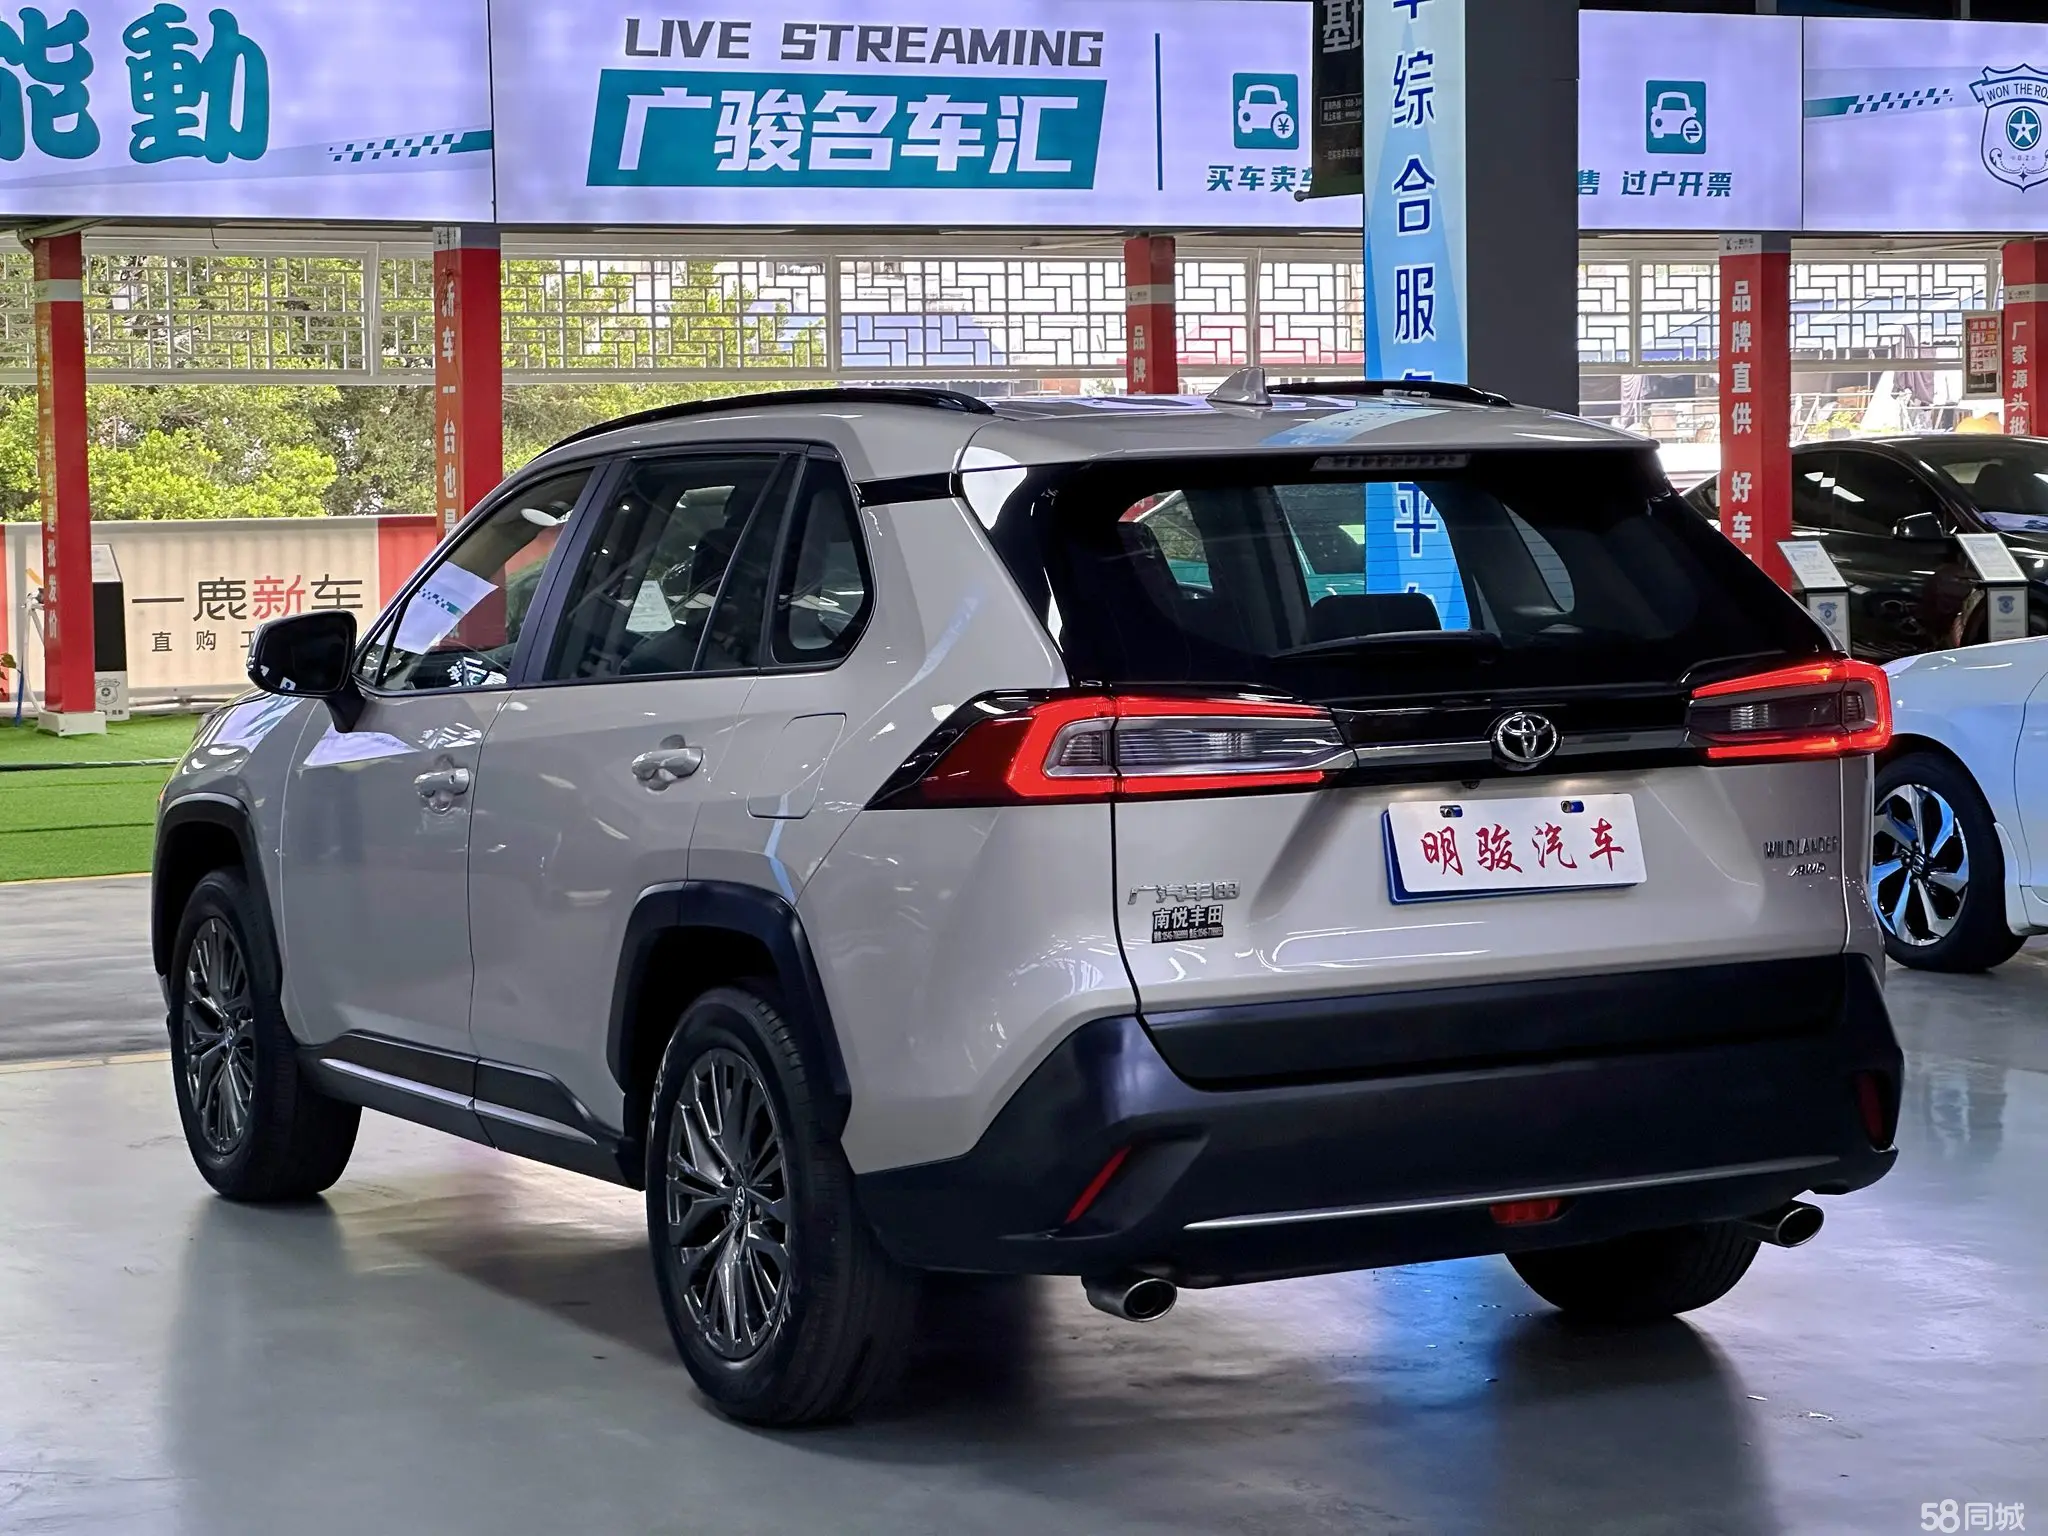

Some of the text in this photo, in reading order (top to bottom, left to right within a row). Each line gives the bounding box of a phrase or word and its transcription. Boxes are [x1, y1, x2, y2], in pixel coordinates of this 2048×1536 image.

[625, 18, 1104, 67] LIVE STREAMING
[0, 4, 269, 164] 能動
[1987, 83, 2048, 101] WON THE RO
[617, 86, 1079, 175] 广骏名车汇
[1392, 0, 1437, 380] 综合服
[1621, 170, 1732, 197] 过户开票
[1133, 325, 1146, 394] 品牌
[2009, 321, 2029, 435] 厂家源头批
[1731, 280, 1753, 558] 品牌直供 好车
[132, 574, 363, 622] 一鹿新车
[1421, 816, 1625, 876] 明骏汽车
[1127, 880, 1240, 905] 广汽丰田
[1153, 905, 1223, 930] 南悦丰田
